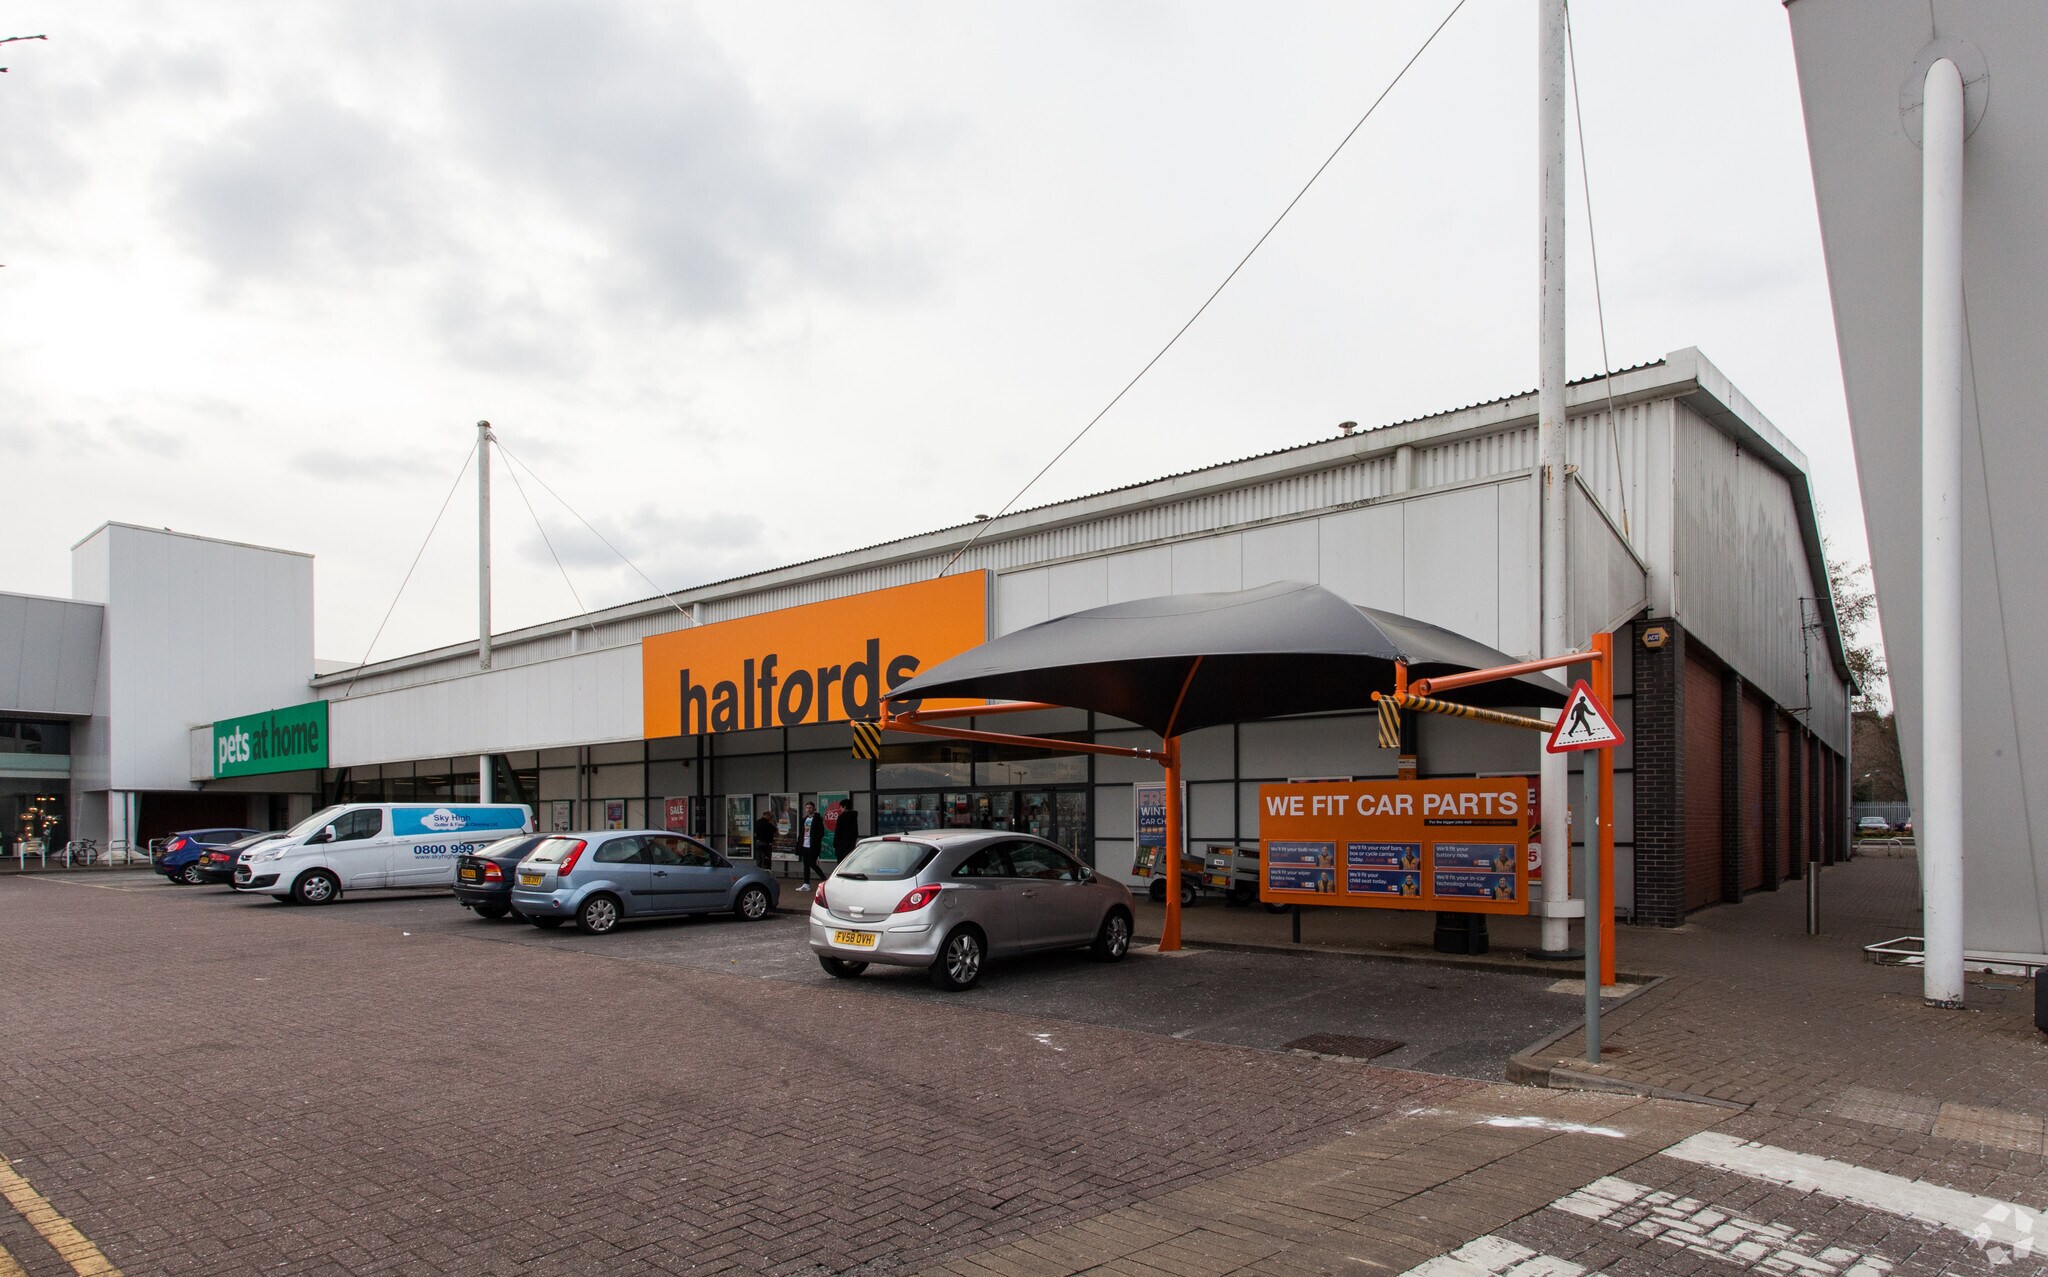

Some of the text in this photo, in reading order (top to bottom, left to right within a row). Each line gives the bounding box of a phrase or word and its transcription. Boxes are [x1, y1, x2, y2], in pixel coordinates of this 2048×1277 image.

[680, 638, 922, 735] halfords
[218, 715, 319, 774] pets at home
[1140, 790, 1166, 806] FRE
[1266, 795, 1304, 816] WE
[1312, 795, 1349, 816] FIT
[1357, 794, 1413, 816] CAR
[1423, 792, 1518, 816] PARTS
[670, 805, 684, 815] SALE
[1140, 806, 1166, 816] WINT
[434, 814, 471, 822] Sky High
[414, 845, 446, 855] 0800
[450, 844, 474, 855] 999
